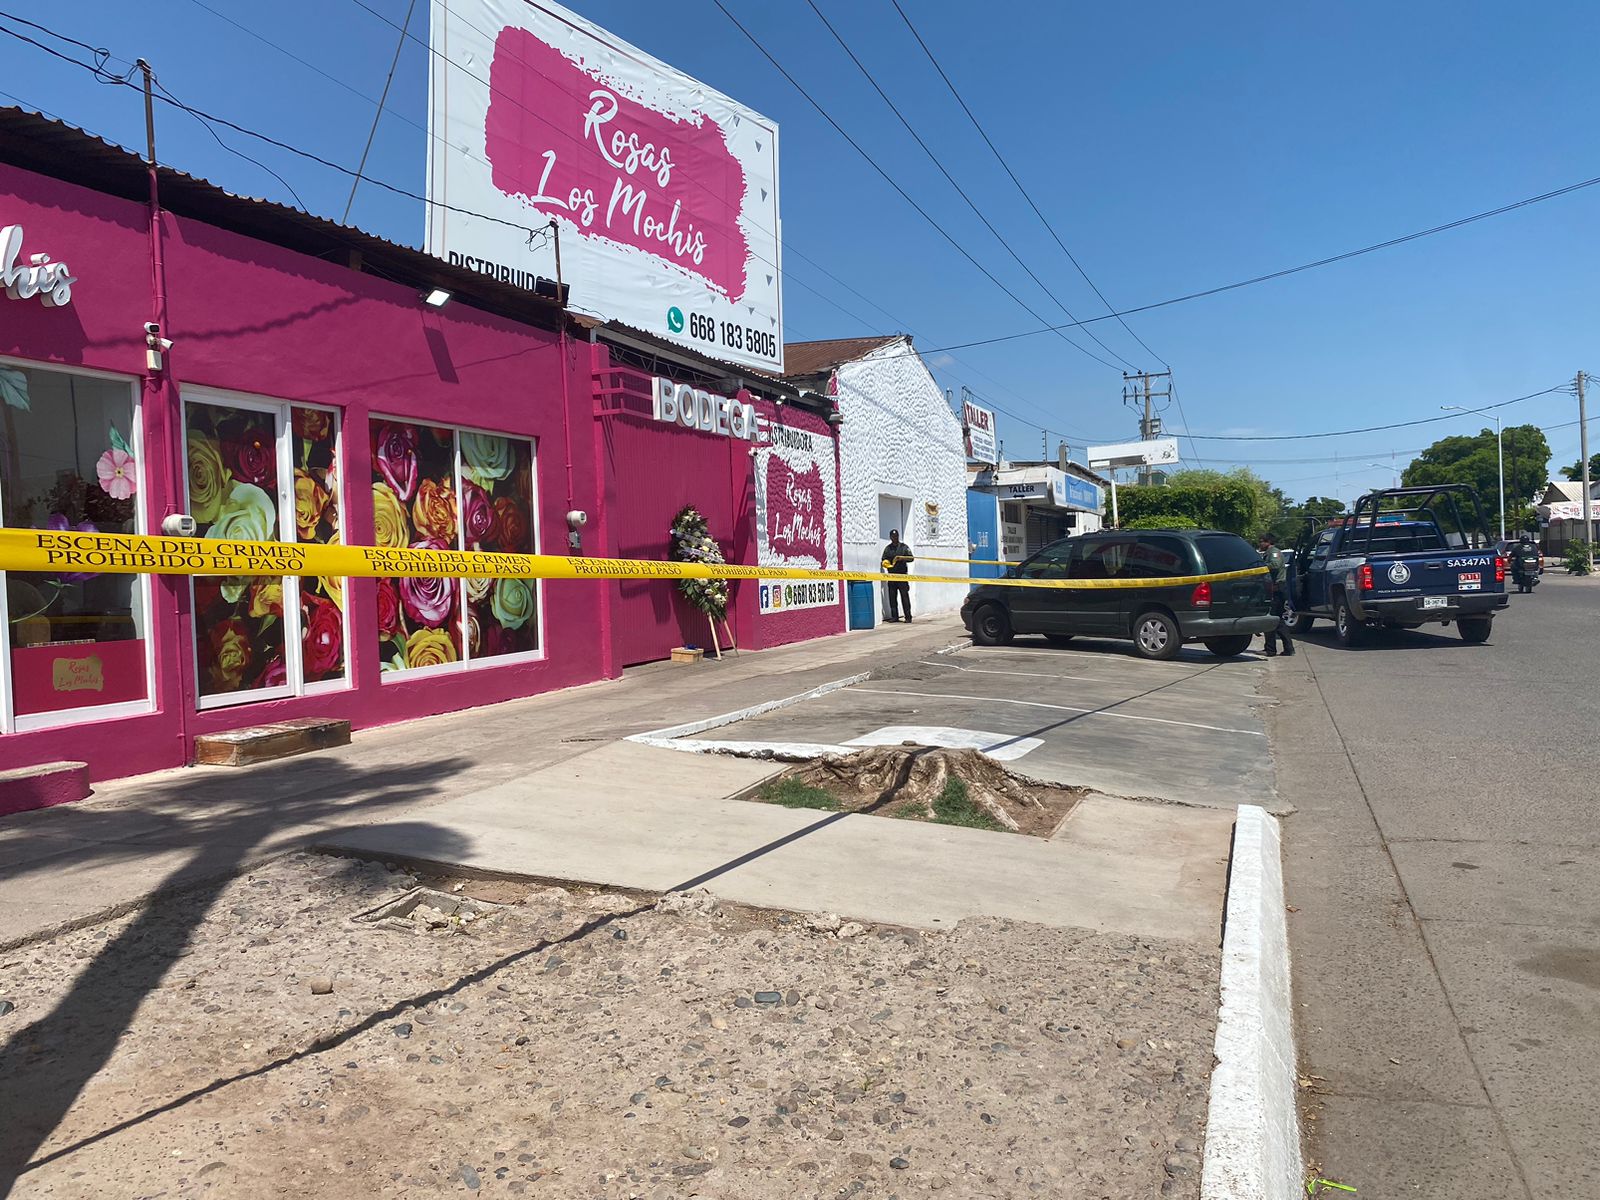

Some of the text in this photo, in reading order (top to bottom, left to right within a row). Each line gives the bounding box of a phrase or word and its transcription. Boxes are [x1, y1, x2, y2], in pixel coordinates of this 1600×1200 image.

[583, 90, 675, 188] Rosas
[531, 151, 708, 265] Los Mochis
[690, 312, 776, 358] 668 183 5805
[652, 376, 762, 443] BODEGA
[786, 472, 812, 512] Rosas
[1008, 485, 1035, 494] TALLER
[774, 512, 821, 548] Los Mochis
[36, 534, 306, 559] ESCENA DEL CRIMEN
[364, 549, 532, 565] ESCENA DEL CRIMEN
[47, 550, 304, 571] PROHIBIDO EL PASO
[372, 561, 531, 574] PROHIBIDO EL PASO
[566, 557, 616, 567] ESCENA
[574, 565, 682, 575] PROHIBIDO EL PASO
[1447, 558, 1491, 568] SA347A1
[711, 567, 757, 576] PROHIBIDO
[768, 569, 788, 577] PASO
